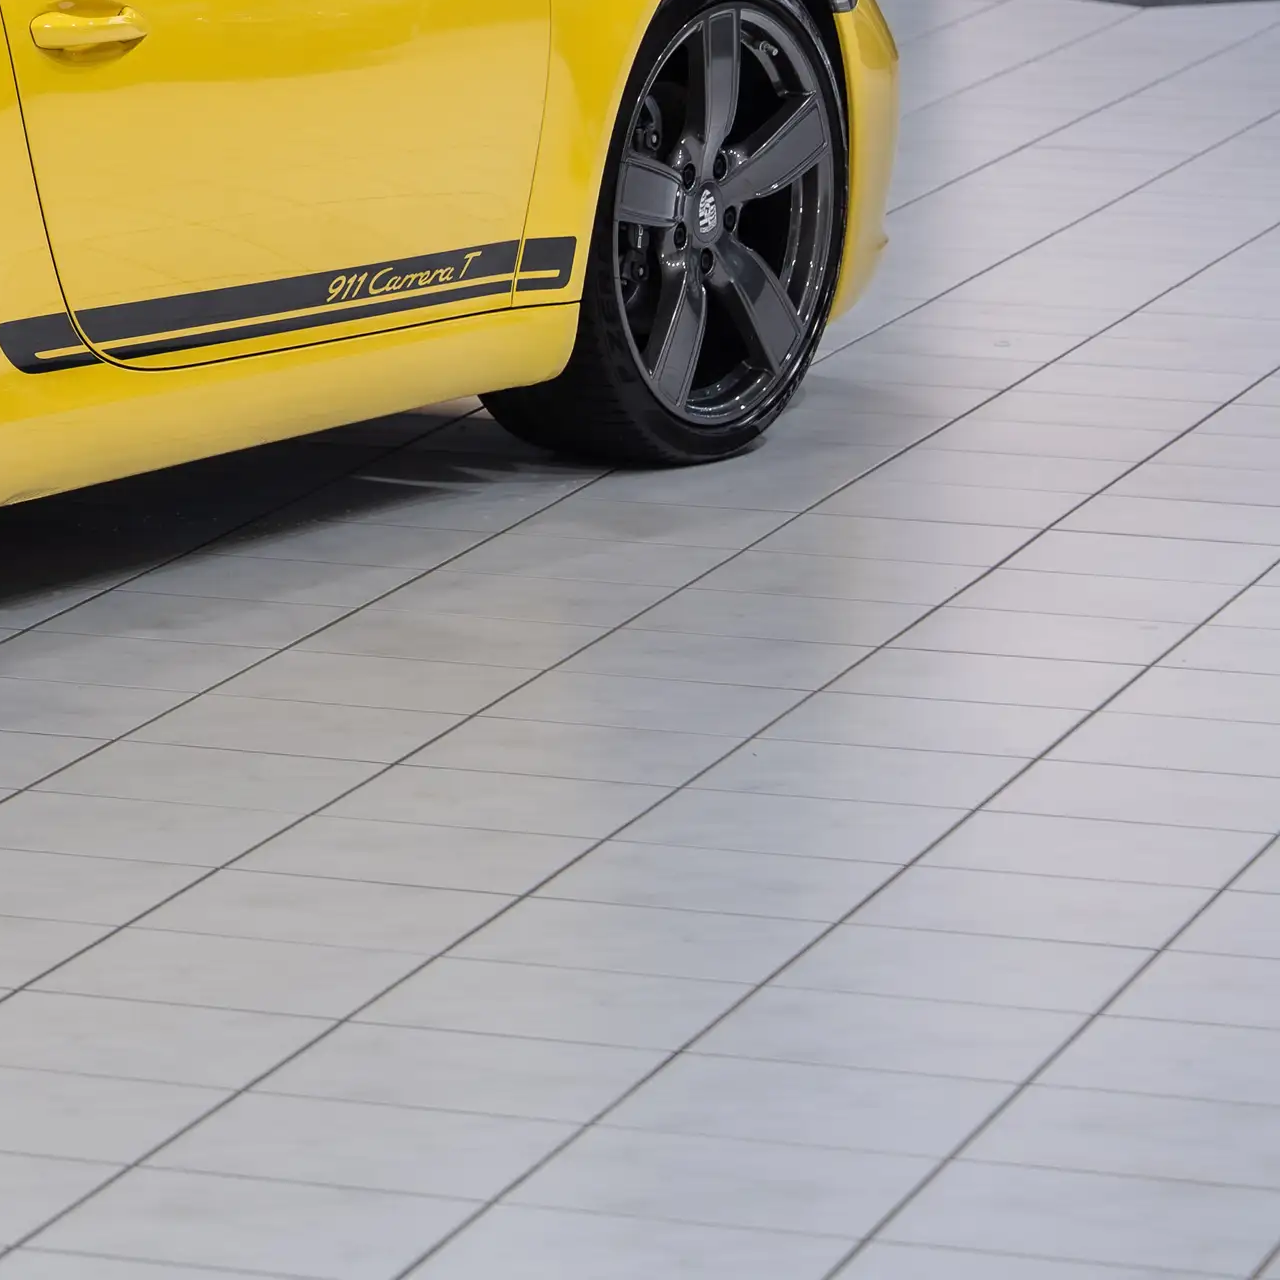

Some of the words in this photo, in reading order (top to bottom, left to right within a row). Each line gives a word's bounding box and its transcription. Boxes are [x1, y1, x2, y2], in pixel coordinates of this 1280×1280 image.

[326, 271, 368, 302] 911
[368, 267, 455, 295] Carrera
[459, 251, 482, 278] T
